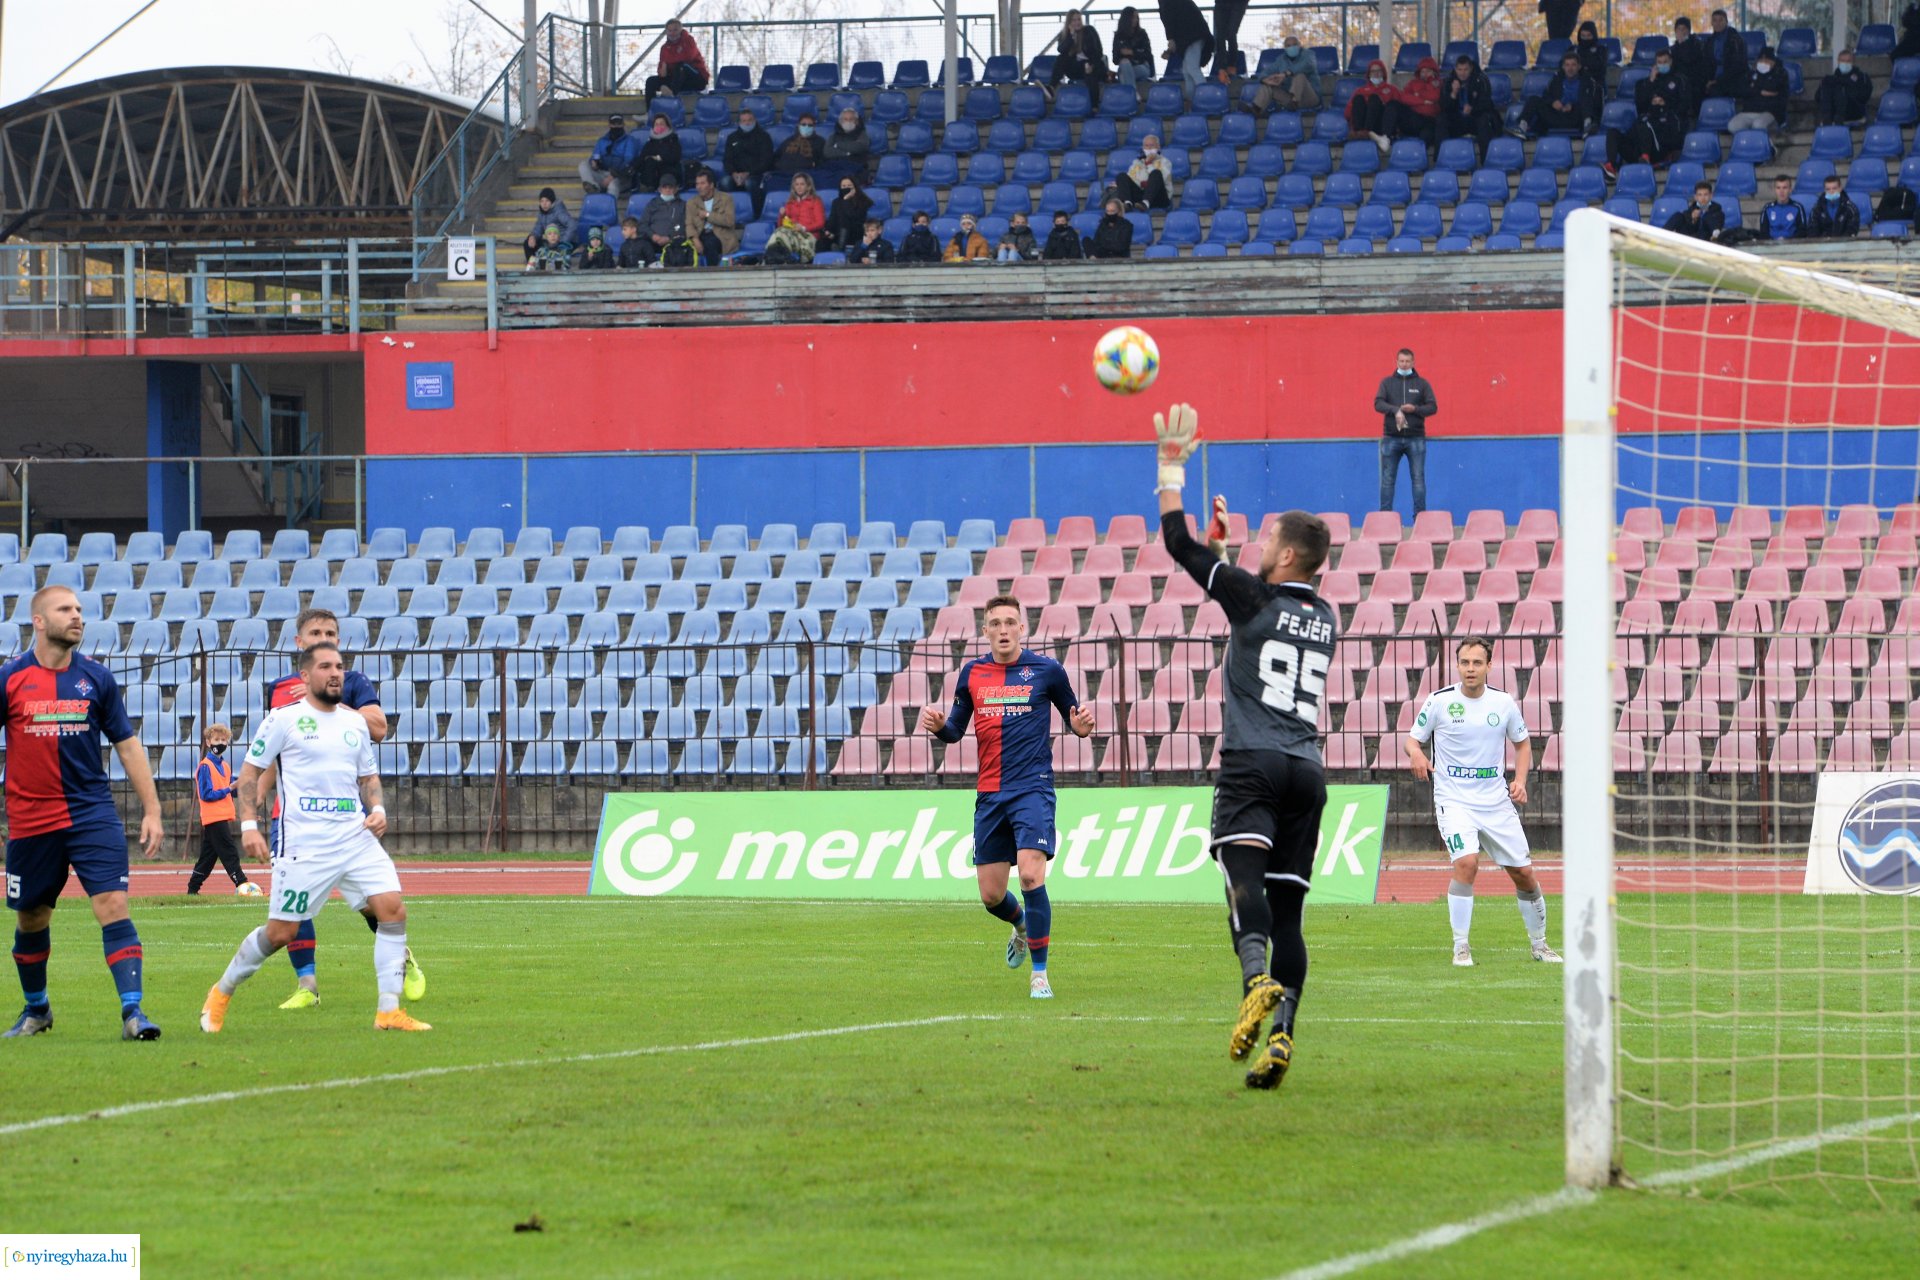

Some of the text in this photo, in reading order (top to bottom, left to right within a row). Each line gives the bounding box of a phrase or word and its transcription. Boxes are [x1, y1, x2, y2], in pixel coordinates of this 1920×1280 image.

[455, 256, 468, 275] C
[1276, 610, 1332, 644] FEJÉR
[716, 802, 1378, 880] merktilbk
[1447, 833, 1464, 853] 14
[281, 889, 310, 914] 28
